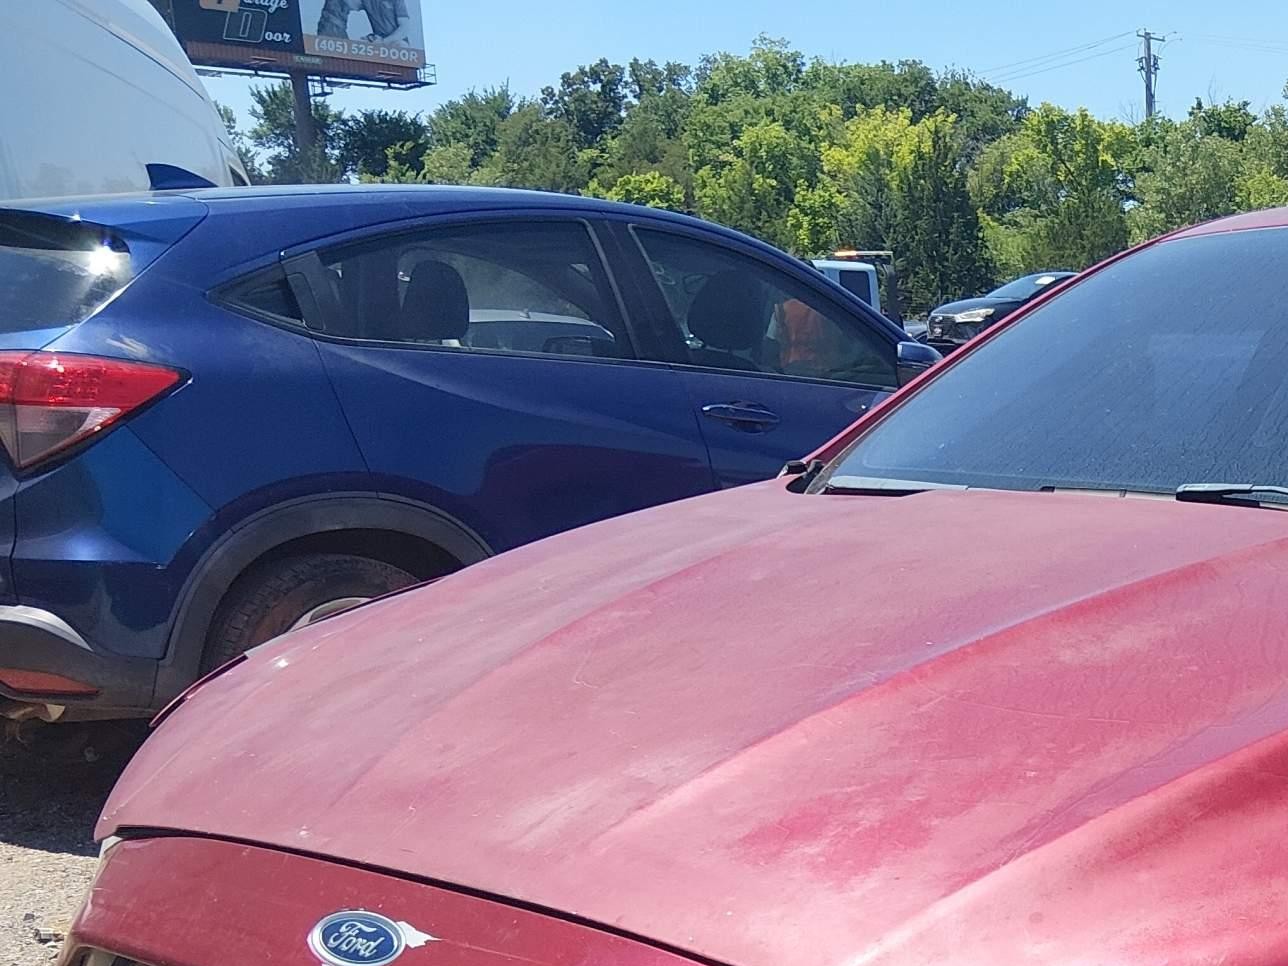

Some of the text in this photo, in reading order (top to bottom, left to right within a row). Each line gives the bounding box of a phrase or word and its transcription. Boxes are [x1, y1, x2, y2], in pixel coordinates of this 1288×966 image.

[314, 39, 418, 62] (405) 525-DOOR
[327, 921, 385, 958] Ford
